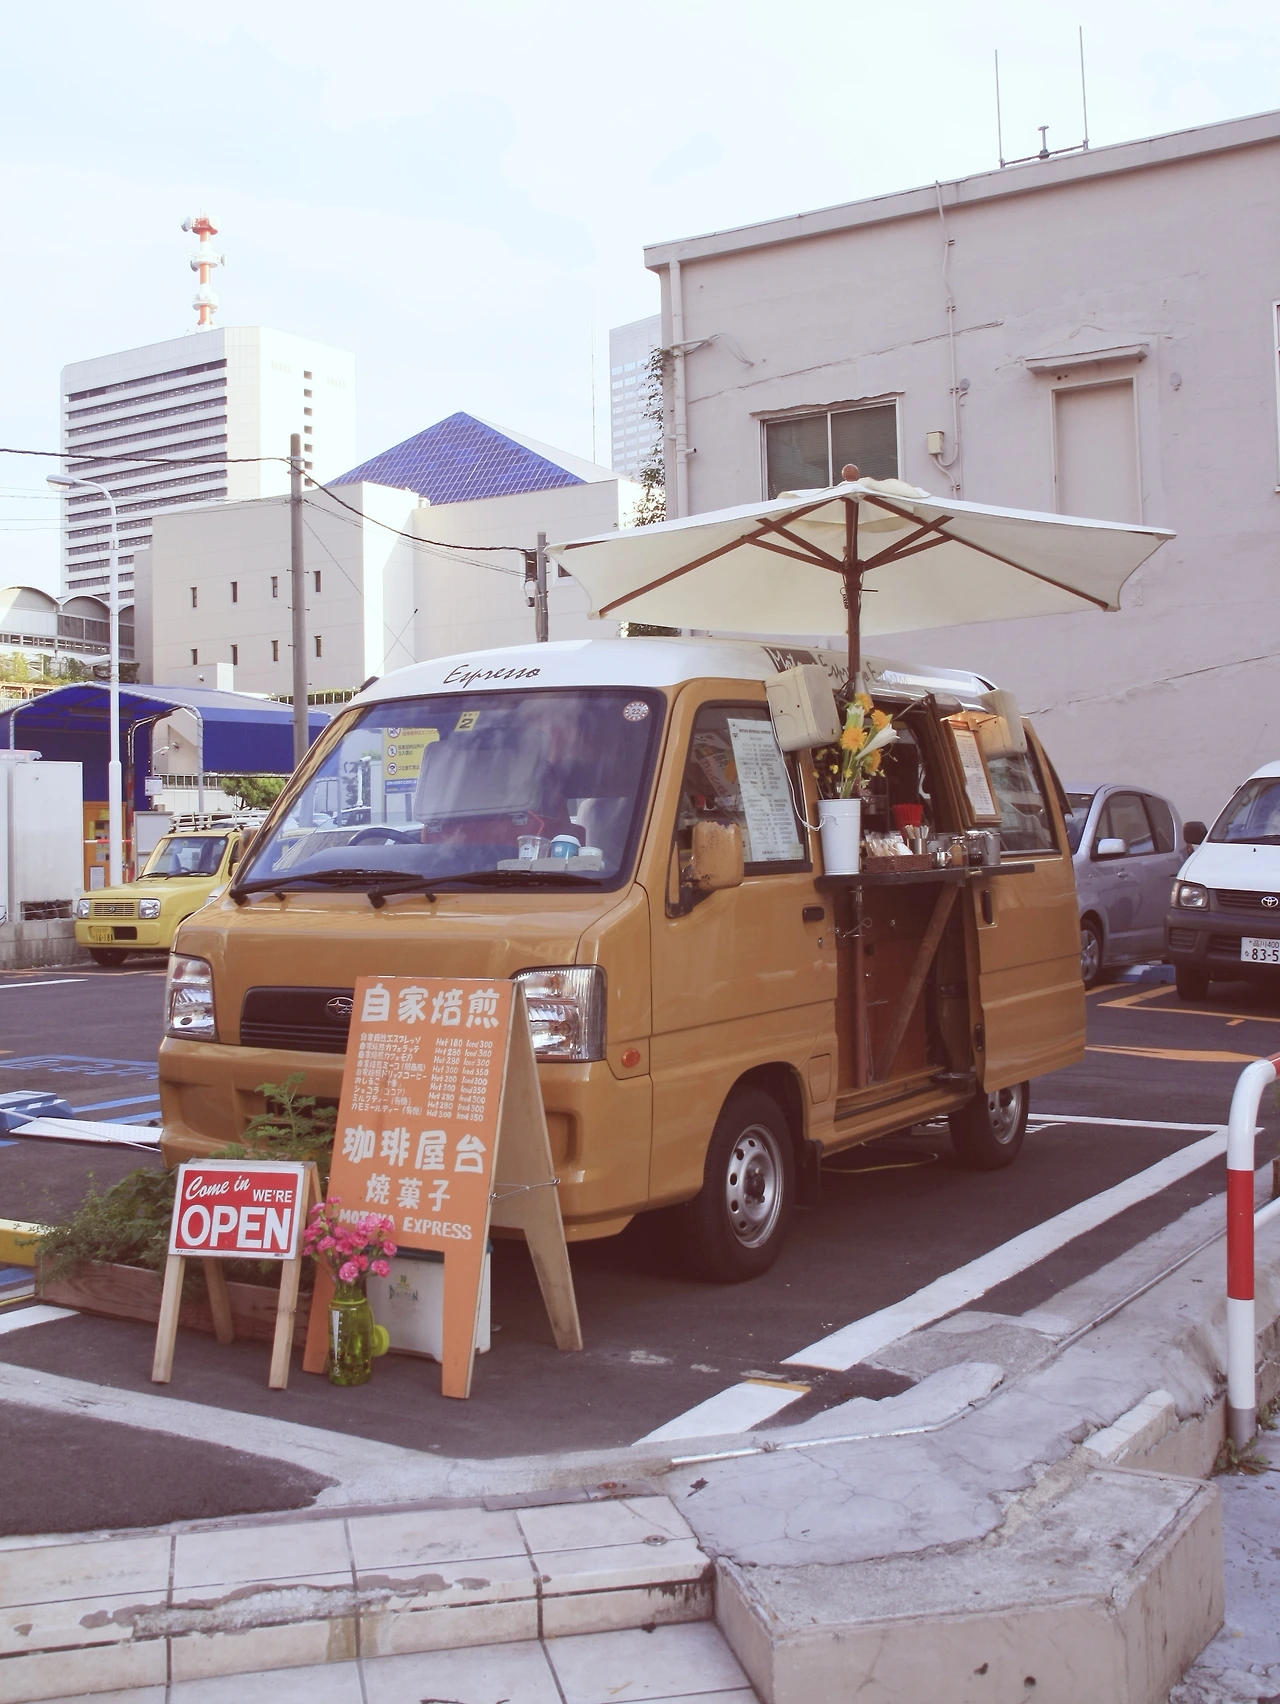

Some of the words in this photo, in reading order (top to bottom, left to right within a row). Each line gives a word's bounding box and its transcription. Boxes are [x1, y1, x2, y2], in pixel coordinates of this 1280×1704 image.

[443, 664, 541, 688] Espresso
[459, 717, 474, 729] 2
[361, 983, 500, 1029] 自家焙煎
[436, 1038, 449, 1047] Hot
[434, 1047, 447, 1055] Hot
[433, 1056, 445, 1064] Hot
[432, 1065, 444, 1073] Hot
[431, 1073, 443, 1082] Hot
[430, 1082, 442, 1091] Hot
[428, 1092, 440, 1100] Hot
[427, 1100, 439, 1109] Hot
[426, 1109, 438, 1117] Hot
[342, 1124, 487, 1174] 珈琲屋台
[185, 1175, 230, 1200] Come
[234, 1175, 250, 1192] in
[365, 1173, 451, 1212] 焼菓子
[253, 1189, 293, 1203] WE'RE
[180, 1204, 292, 1250] OPEN
[339, 1208, 395, 1226] MOTYA
[402, 1216, 473, 1241] EXPRESS
